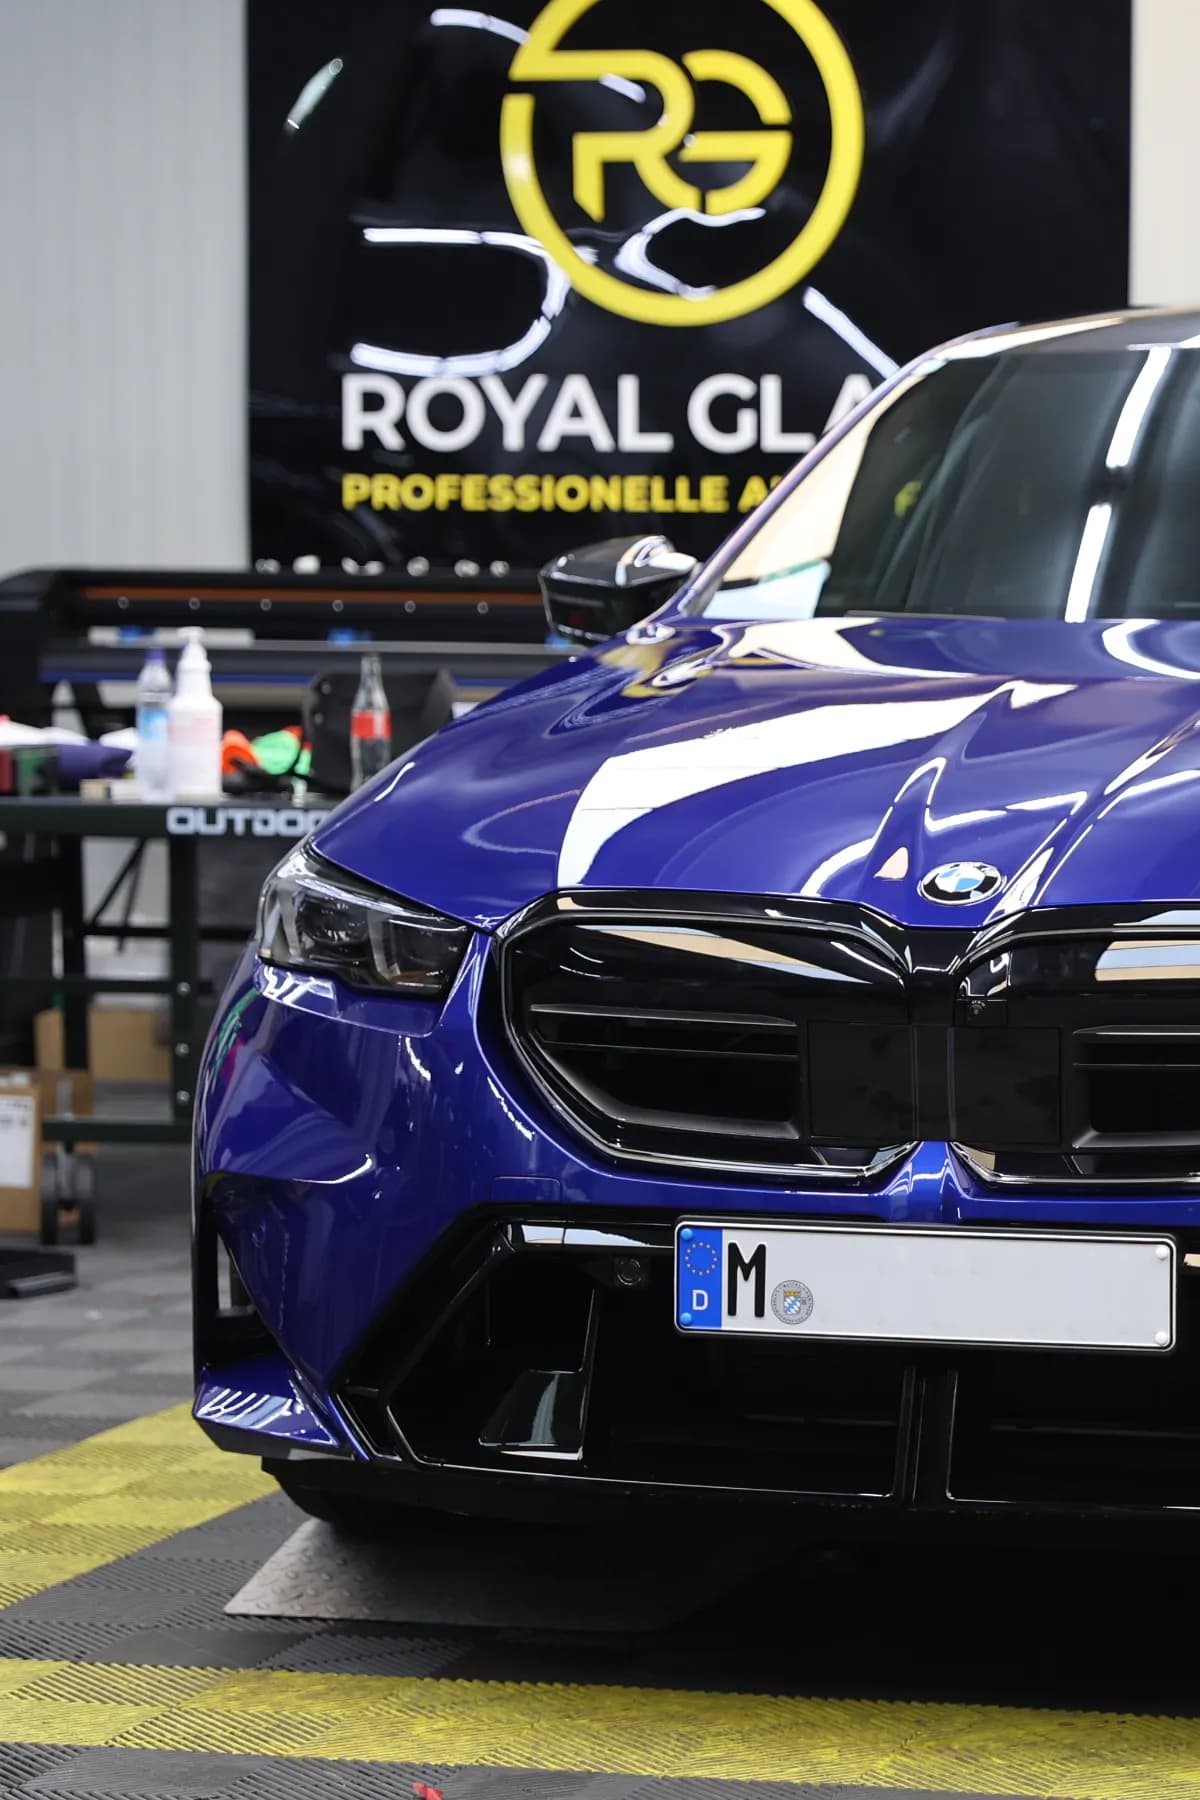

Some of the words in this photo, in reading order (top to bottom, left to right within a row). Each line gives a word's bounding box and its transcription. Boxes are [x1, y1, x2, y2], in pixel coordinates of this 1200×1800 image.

[573, 50, 792, 221] RG
[341, 373, 672, 453] ROYAL
[342, 475, 729, 513] PROFESSIONELLE
[692, 1290, 708, 1310] D
[728, 1242, 766, 1318] M
